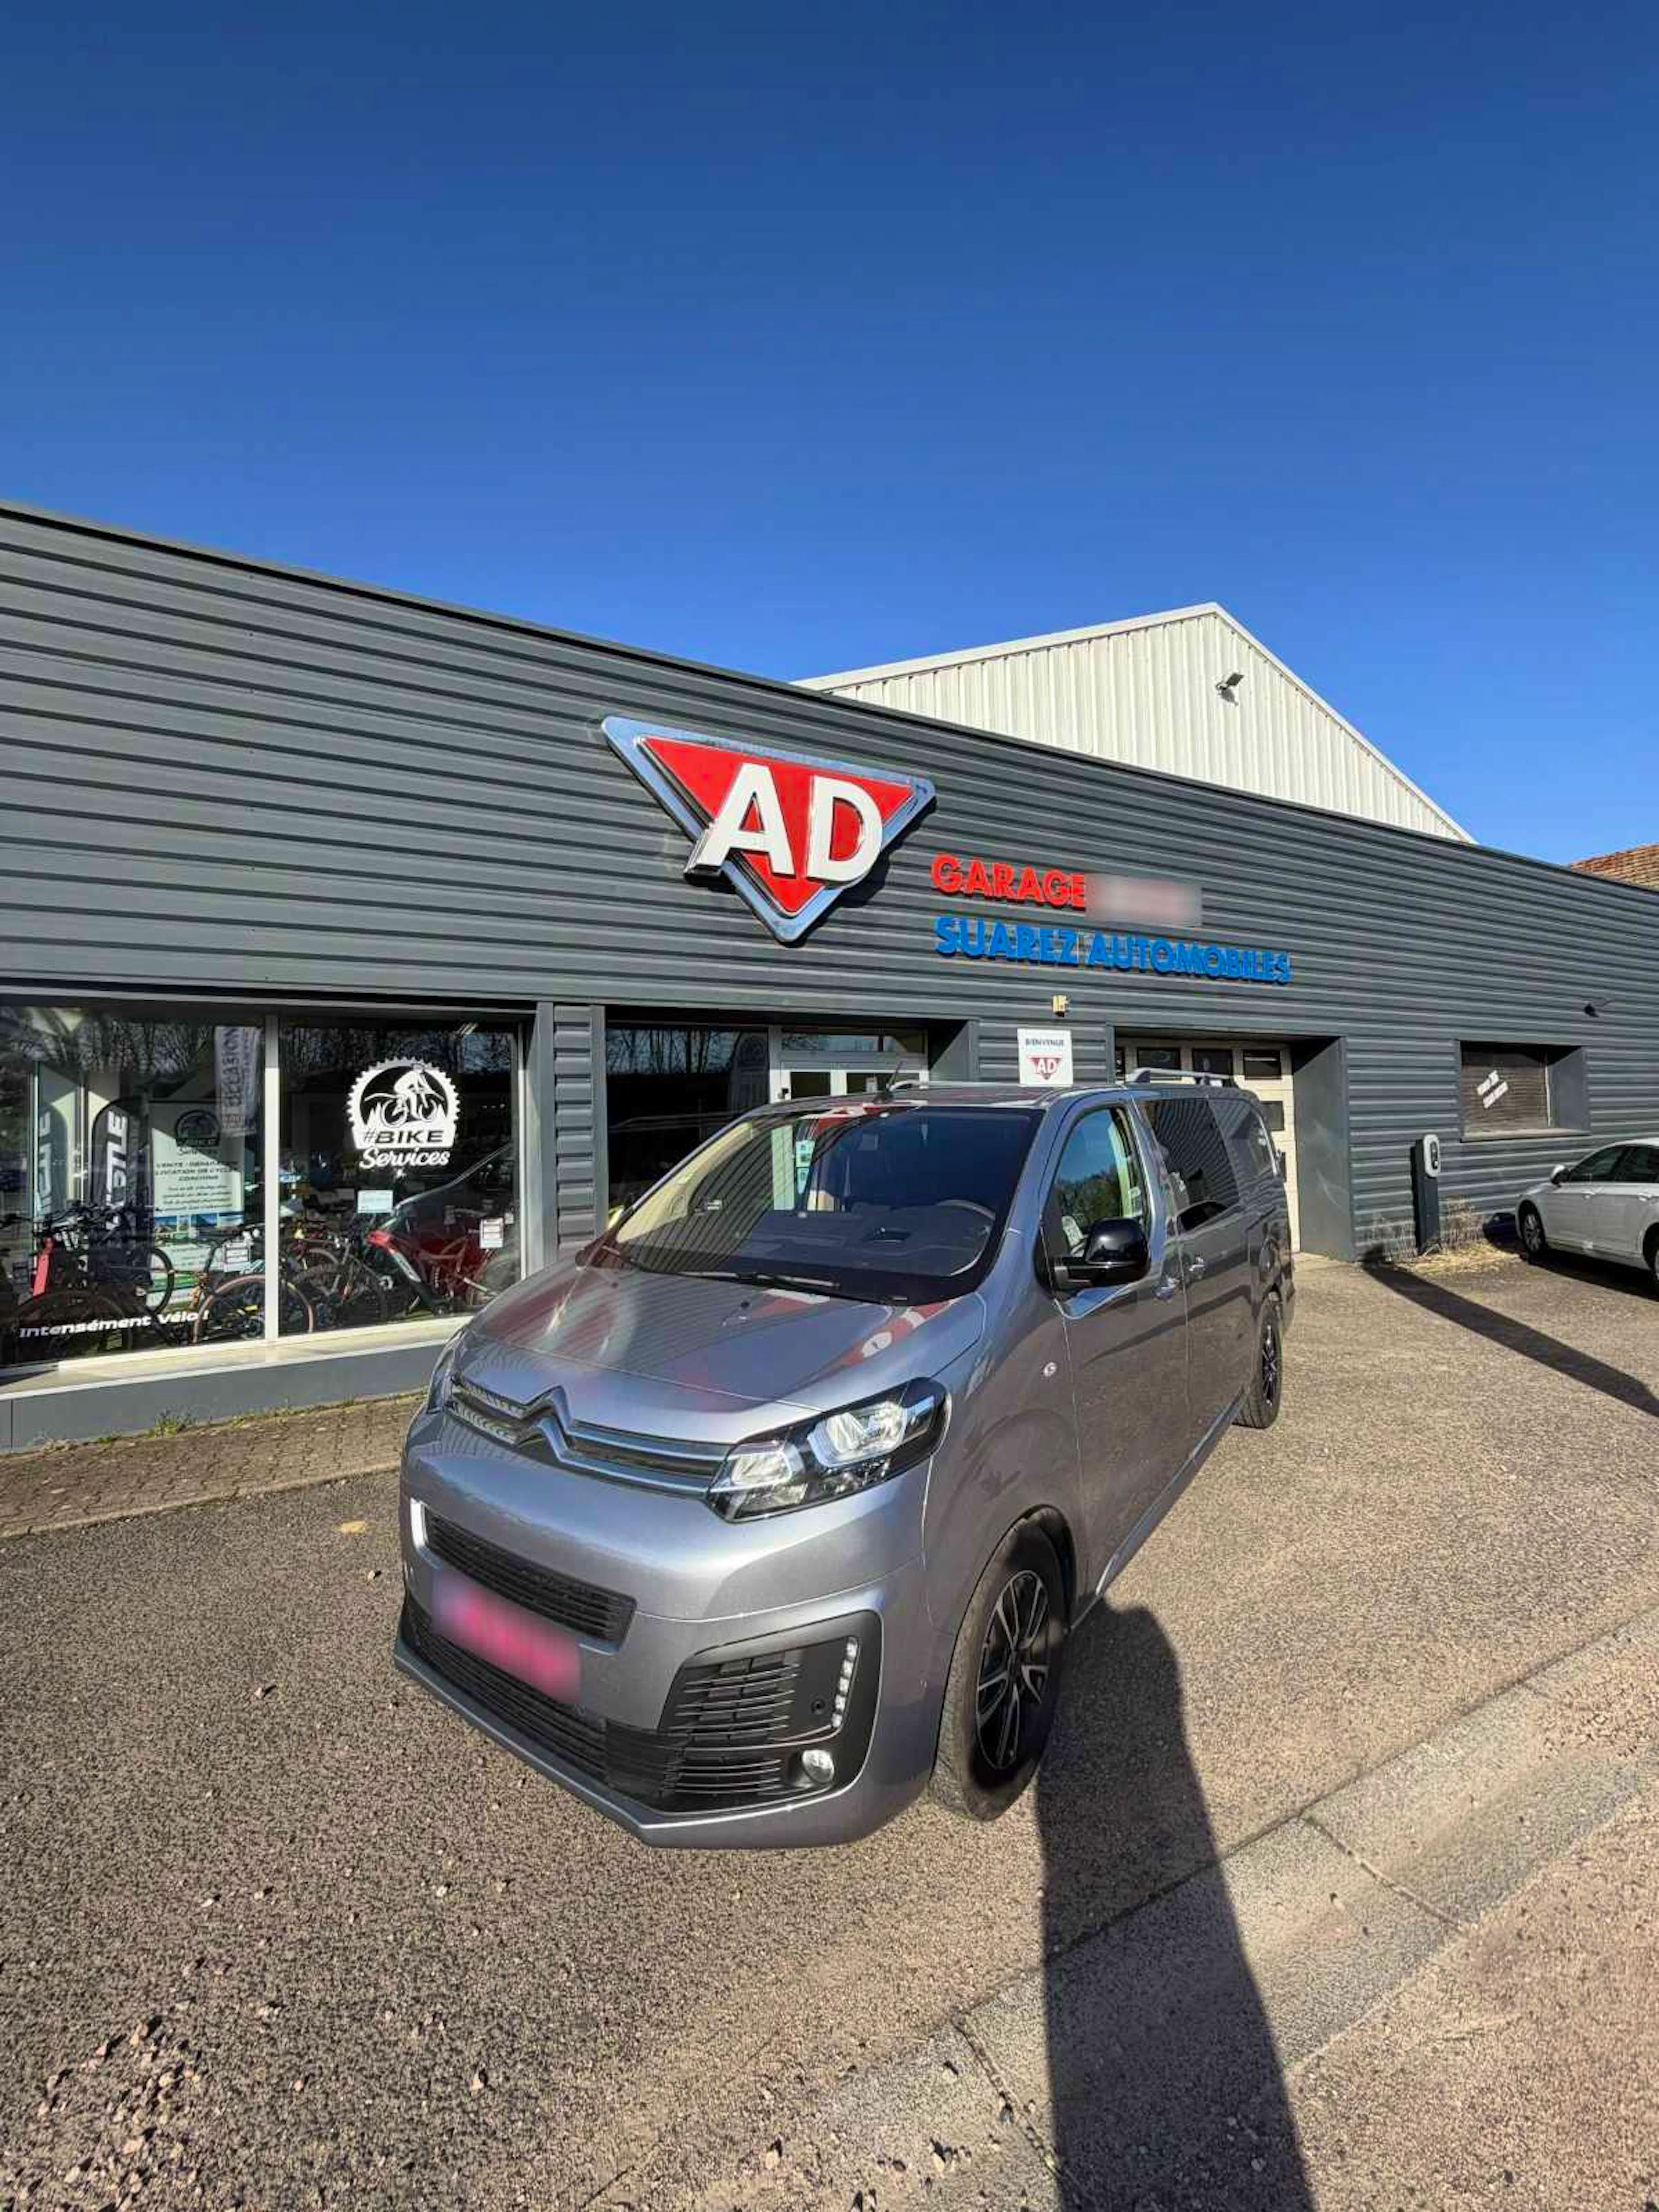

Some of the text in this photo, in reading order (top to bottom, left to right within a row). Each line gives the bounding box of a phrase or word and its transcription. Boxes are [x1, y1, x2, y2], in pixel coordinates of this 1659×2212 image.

[684, 763, 883, 882] AD
[930, 852, 1085, 908] GARAGE
[934, 917, 1079, 963] SUAREZ
[1087, 930, 1293, 984] AUTOMOBILES
[1025, 1038, 1064, 1047] BIENVENUE
[1035, 1058, 1057, 1074] AD
[364, 1128, 444, 1144] #BIKE
[359, 1146, 451, 1169] Services
[19, 1315, 152, 1338] Intensément
[157, 1311, 199, 1324] Vélo
